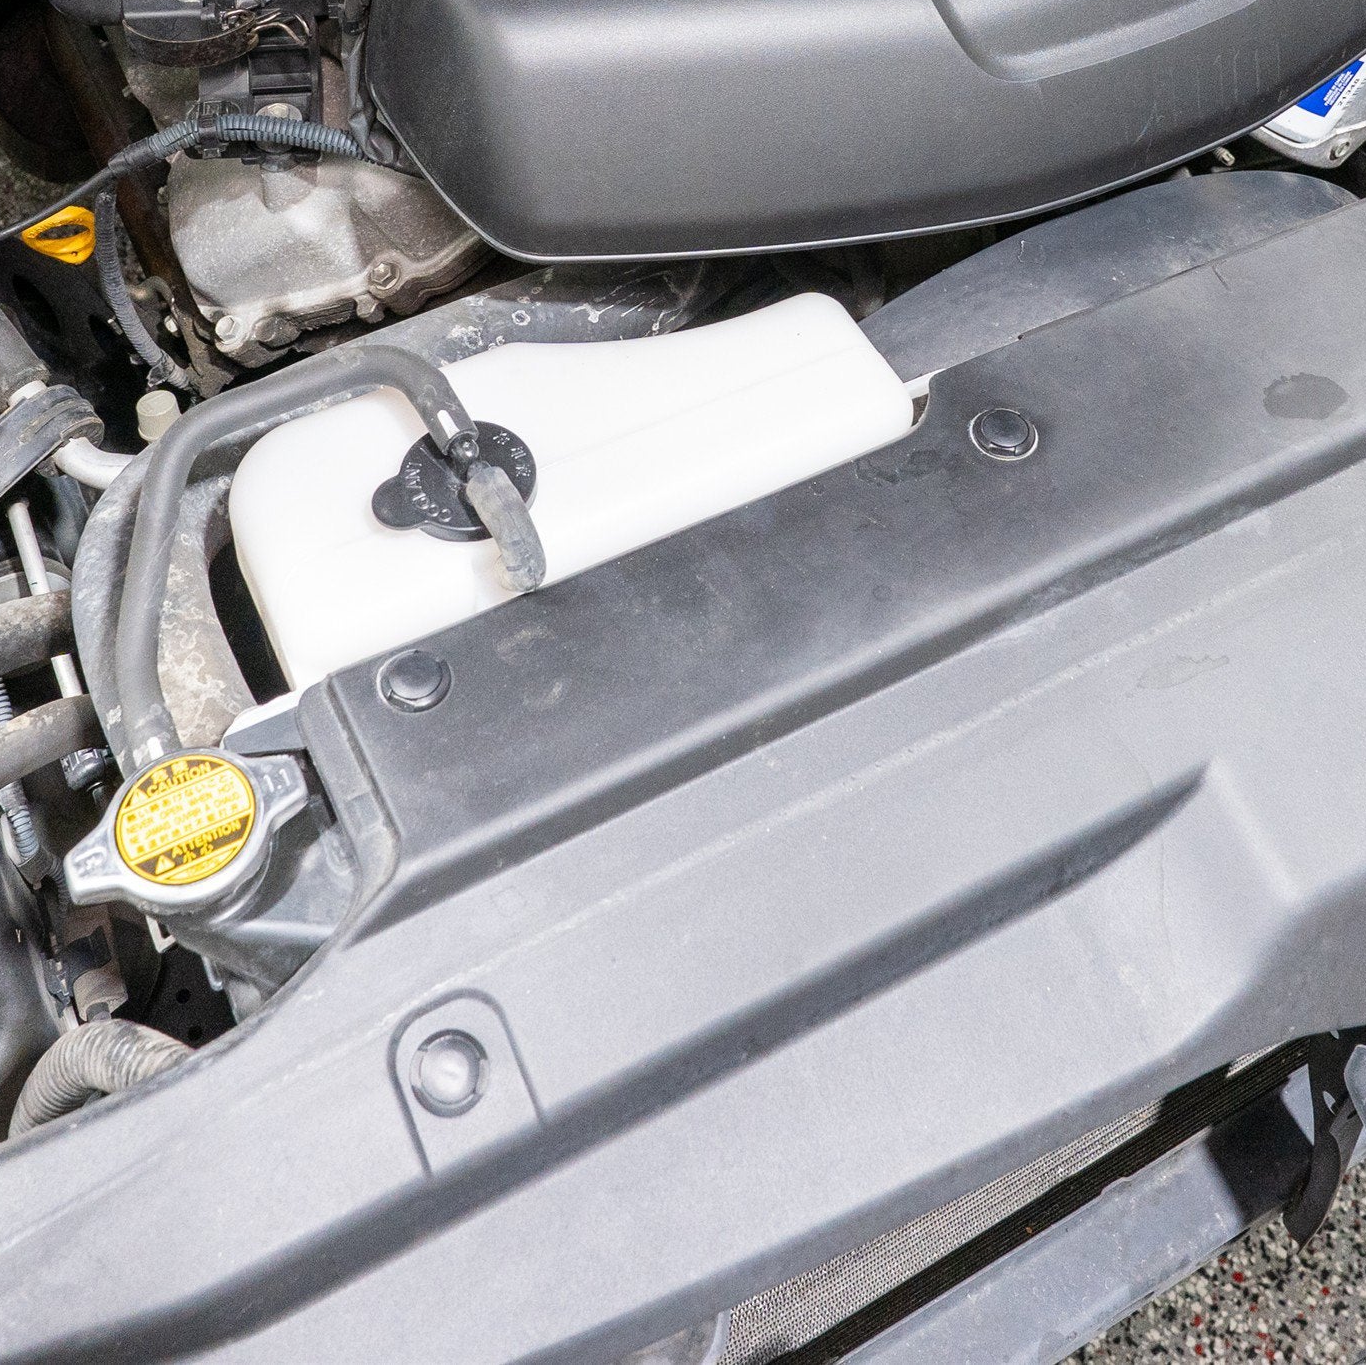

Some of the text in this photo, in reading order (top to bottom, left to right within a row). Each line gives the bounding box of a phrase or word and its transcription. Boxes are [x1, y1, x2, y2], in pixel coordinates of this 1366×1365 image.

[146, 762, 212, 798] CAUTION
[263, 768, 291, 793] 1.1
[126, 781, 235, 834] NEVER OPEN WHEN HOT
[171, 819, 242, 858] ATTENTION
